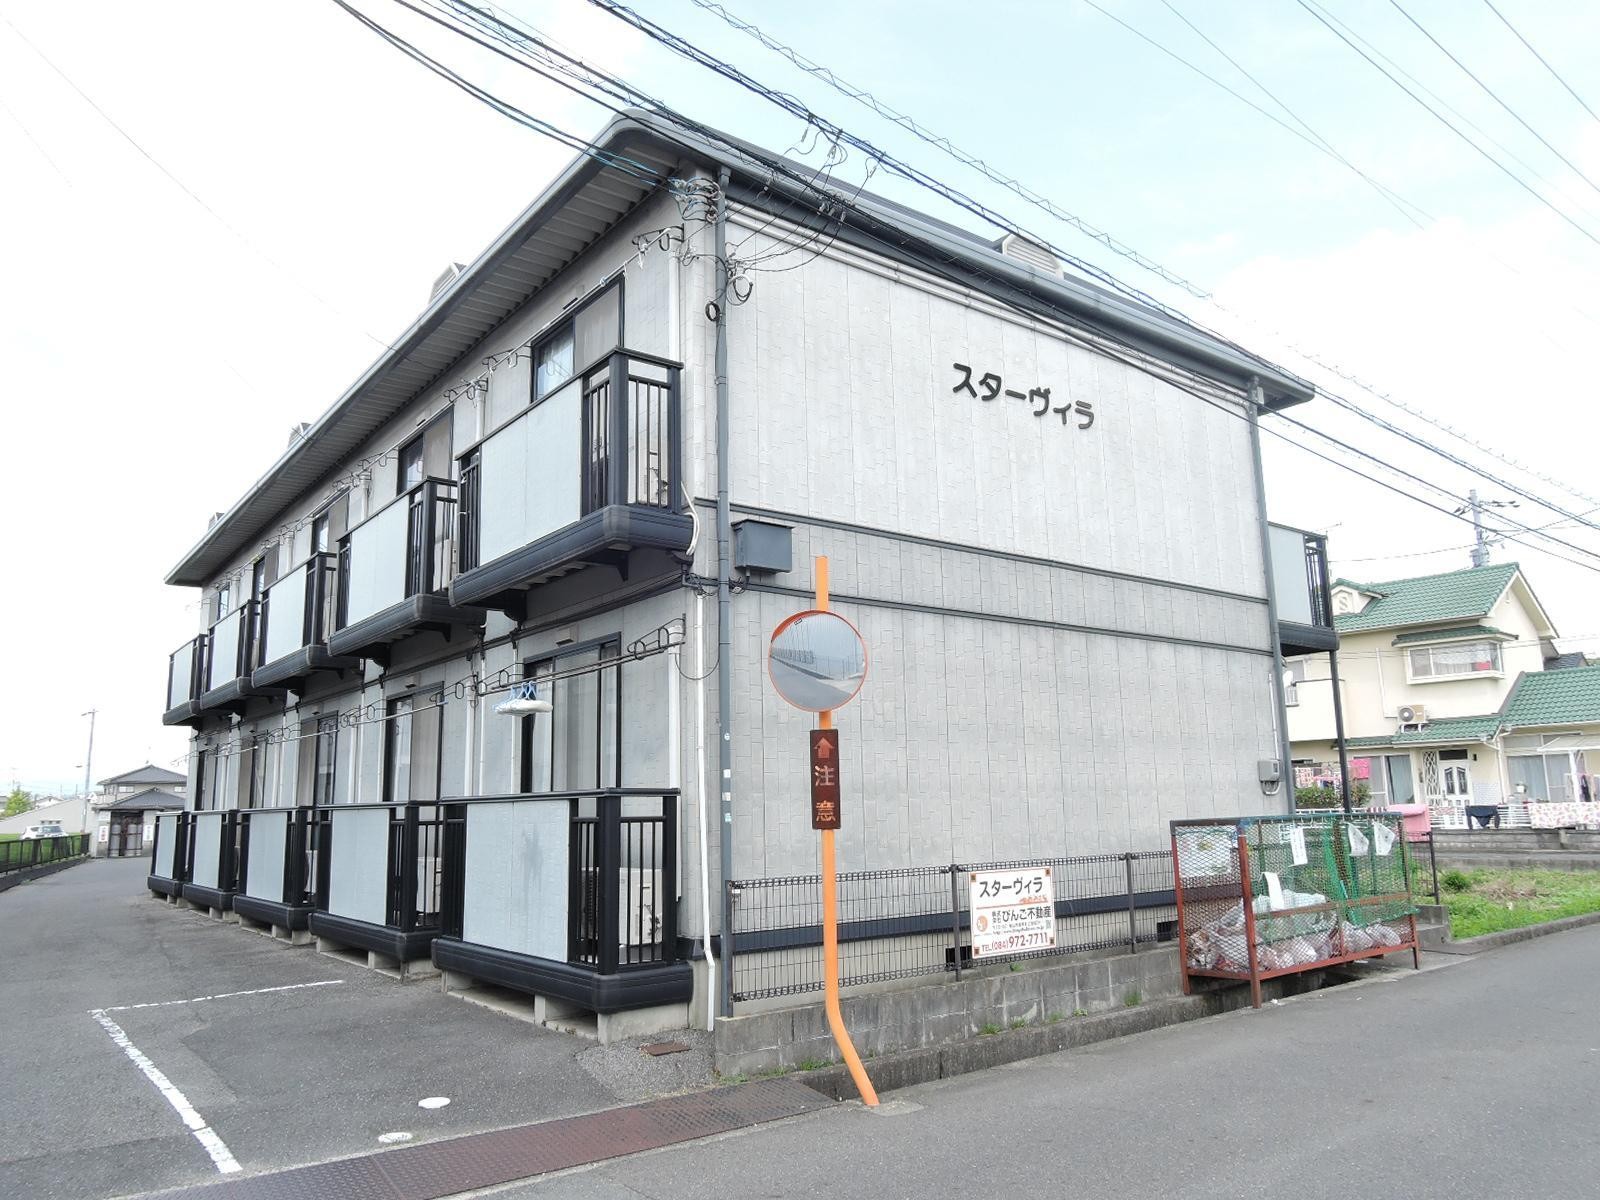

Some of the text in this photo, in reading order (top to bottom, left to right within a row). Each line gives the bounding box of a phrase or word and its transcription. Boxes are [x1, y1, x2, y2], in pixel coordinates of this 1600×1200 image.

[953, 362, 1094, 429] スターヴィラ
[814, 765, 836, 822] 注意
[979, 876, 1043, 898] スターヴィラ
